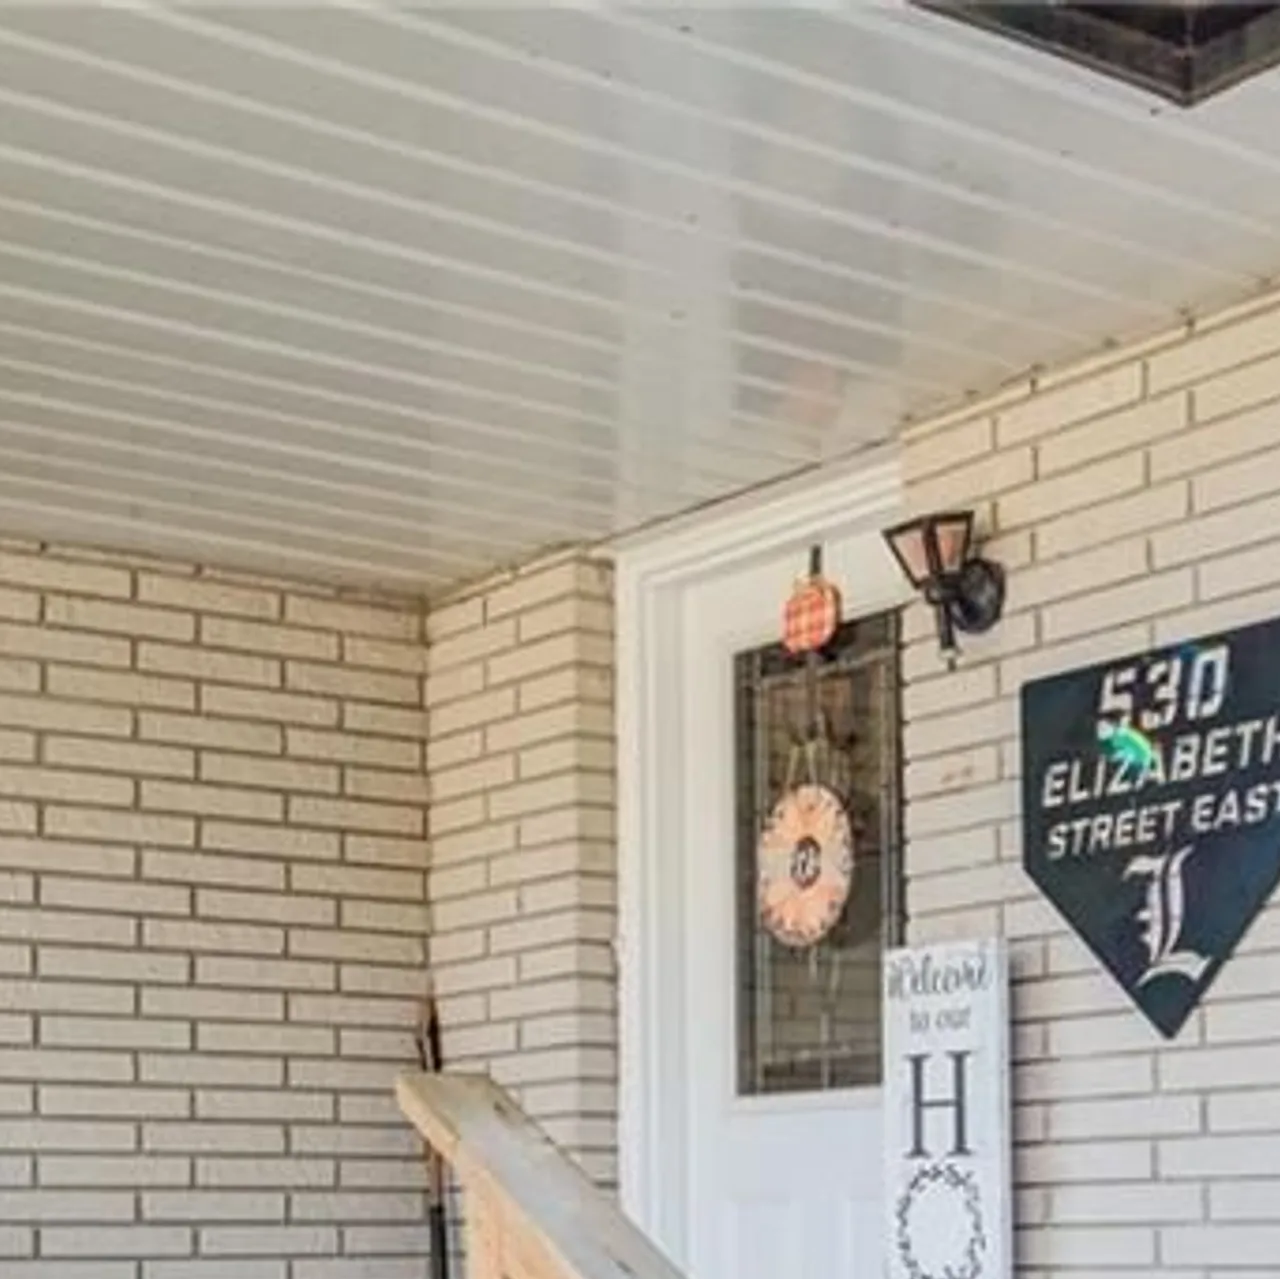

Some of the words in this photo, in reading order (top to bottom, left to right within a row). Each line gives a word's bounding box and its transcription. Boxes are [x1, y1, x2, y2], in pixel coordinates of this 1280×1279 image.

[1097, 646, 1230, 738] 530
[1047, 801, 1183, 861] STREET
[1122, 844, 1211, 987] L
[909, 1009, 930, 1033] to
[934, 1008, 972, 1033] our
